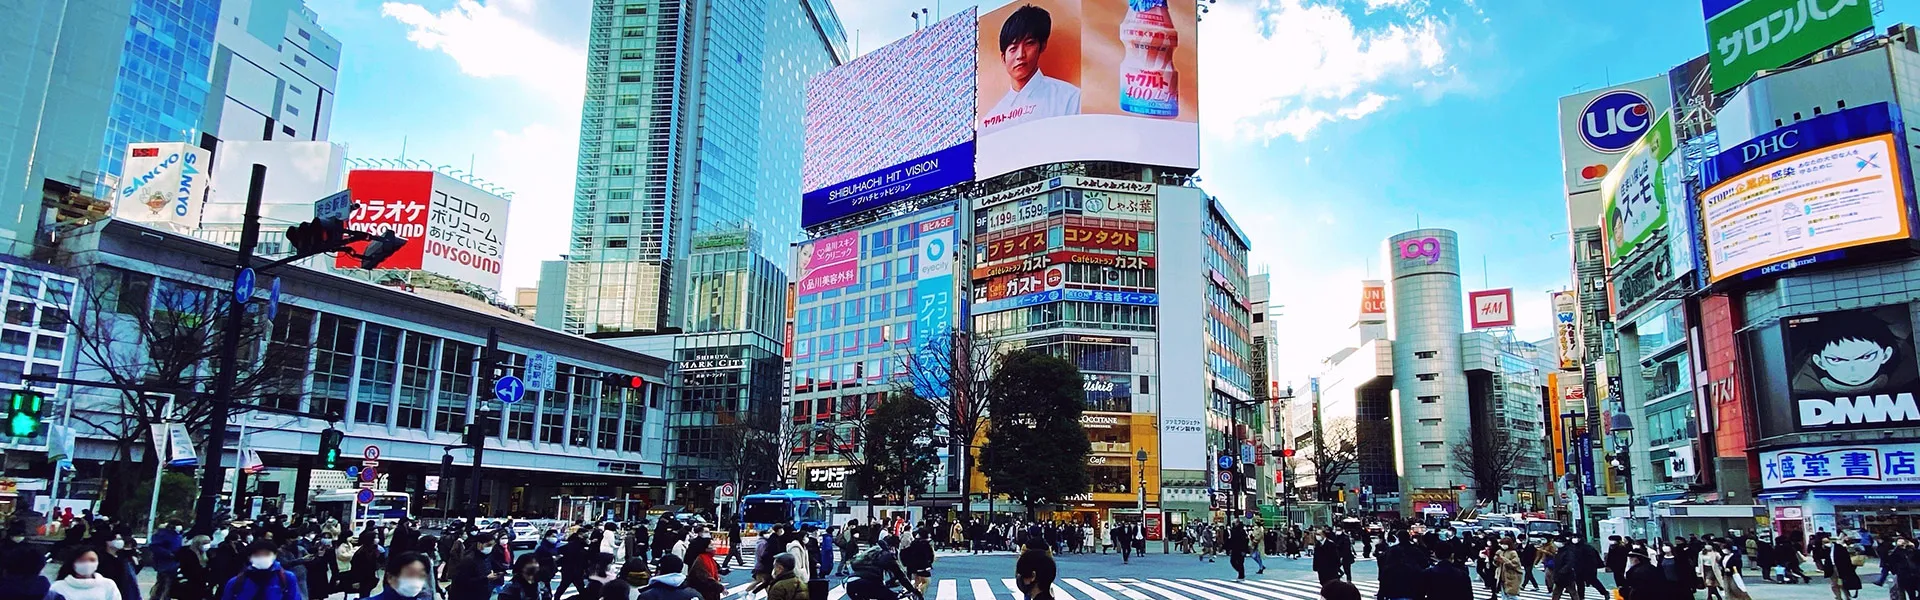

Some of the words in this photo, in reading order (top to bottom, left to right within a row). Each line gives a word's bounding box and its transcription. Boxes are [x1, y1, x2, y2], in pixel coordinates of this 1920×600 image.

[1125, 73, 1168, 88] ヤクルト
[1126, 86, 1152, 100] 400
[984, 114, 1006, 127] ヤクルト
[1008, 108, 1023, 119] 400
[1741, 130, 1798, 163] DHC
[123, 153, 179, 198] SANKYO
[175, 152, 199, 216] SANKYO
[829, 177, 882, 200] SHIBUHACHI
[886, 170, 901, 183] HIT
[905, 159, 939, 177] VISION
[1076, 178, 1152, 192] しゃぶしゃぶバイキング
[852, 184, 911, 206] シブハチヒットビジョン
[1622, 175, 1652, 223] スーモ
[350, 200, 425, 222] カラオケ
[433, 190, 490, 222] ココロの
[1108, 197, 1152, 213] しゃぶ葉
[977, 217, 987, 227] 9F
[825, 238, 856, 250] 品川スキン
[1065, 228, 1135, 247] コンタクト
[426, 240, 500, 274] JOYSOUND
[825, 248, 852, 261] クリニック
[1399, 237, 1440, 265] 109
[1022, 256, 1051, 271] ガスト
[1115, 256, 1148, 269] ガスト
[807, 270, 854, 289] 品川美容外科
[1006, 276, 1041, 296] ガスト
[974, 286, 987, 299] 7F
[1095, 292, 1156, 304] 英会話イーオン
[679, 361, 714, 369] MARK
[718, 359, 746, 367] CITY
[1798, 393, 1920, 426] DMM
[1766, 450, 1916, 480] 大盛堂書店
[1065, 493, 1094, 501] ANE
